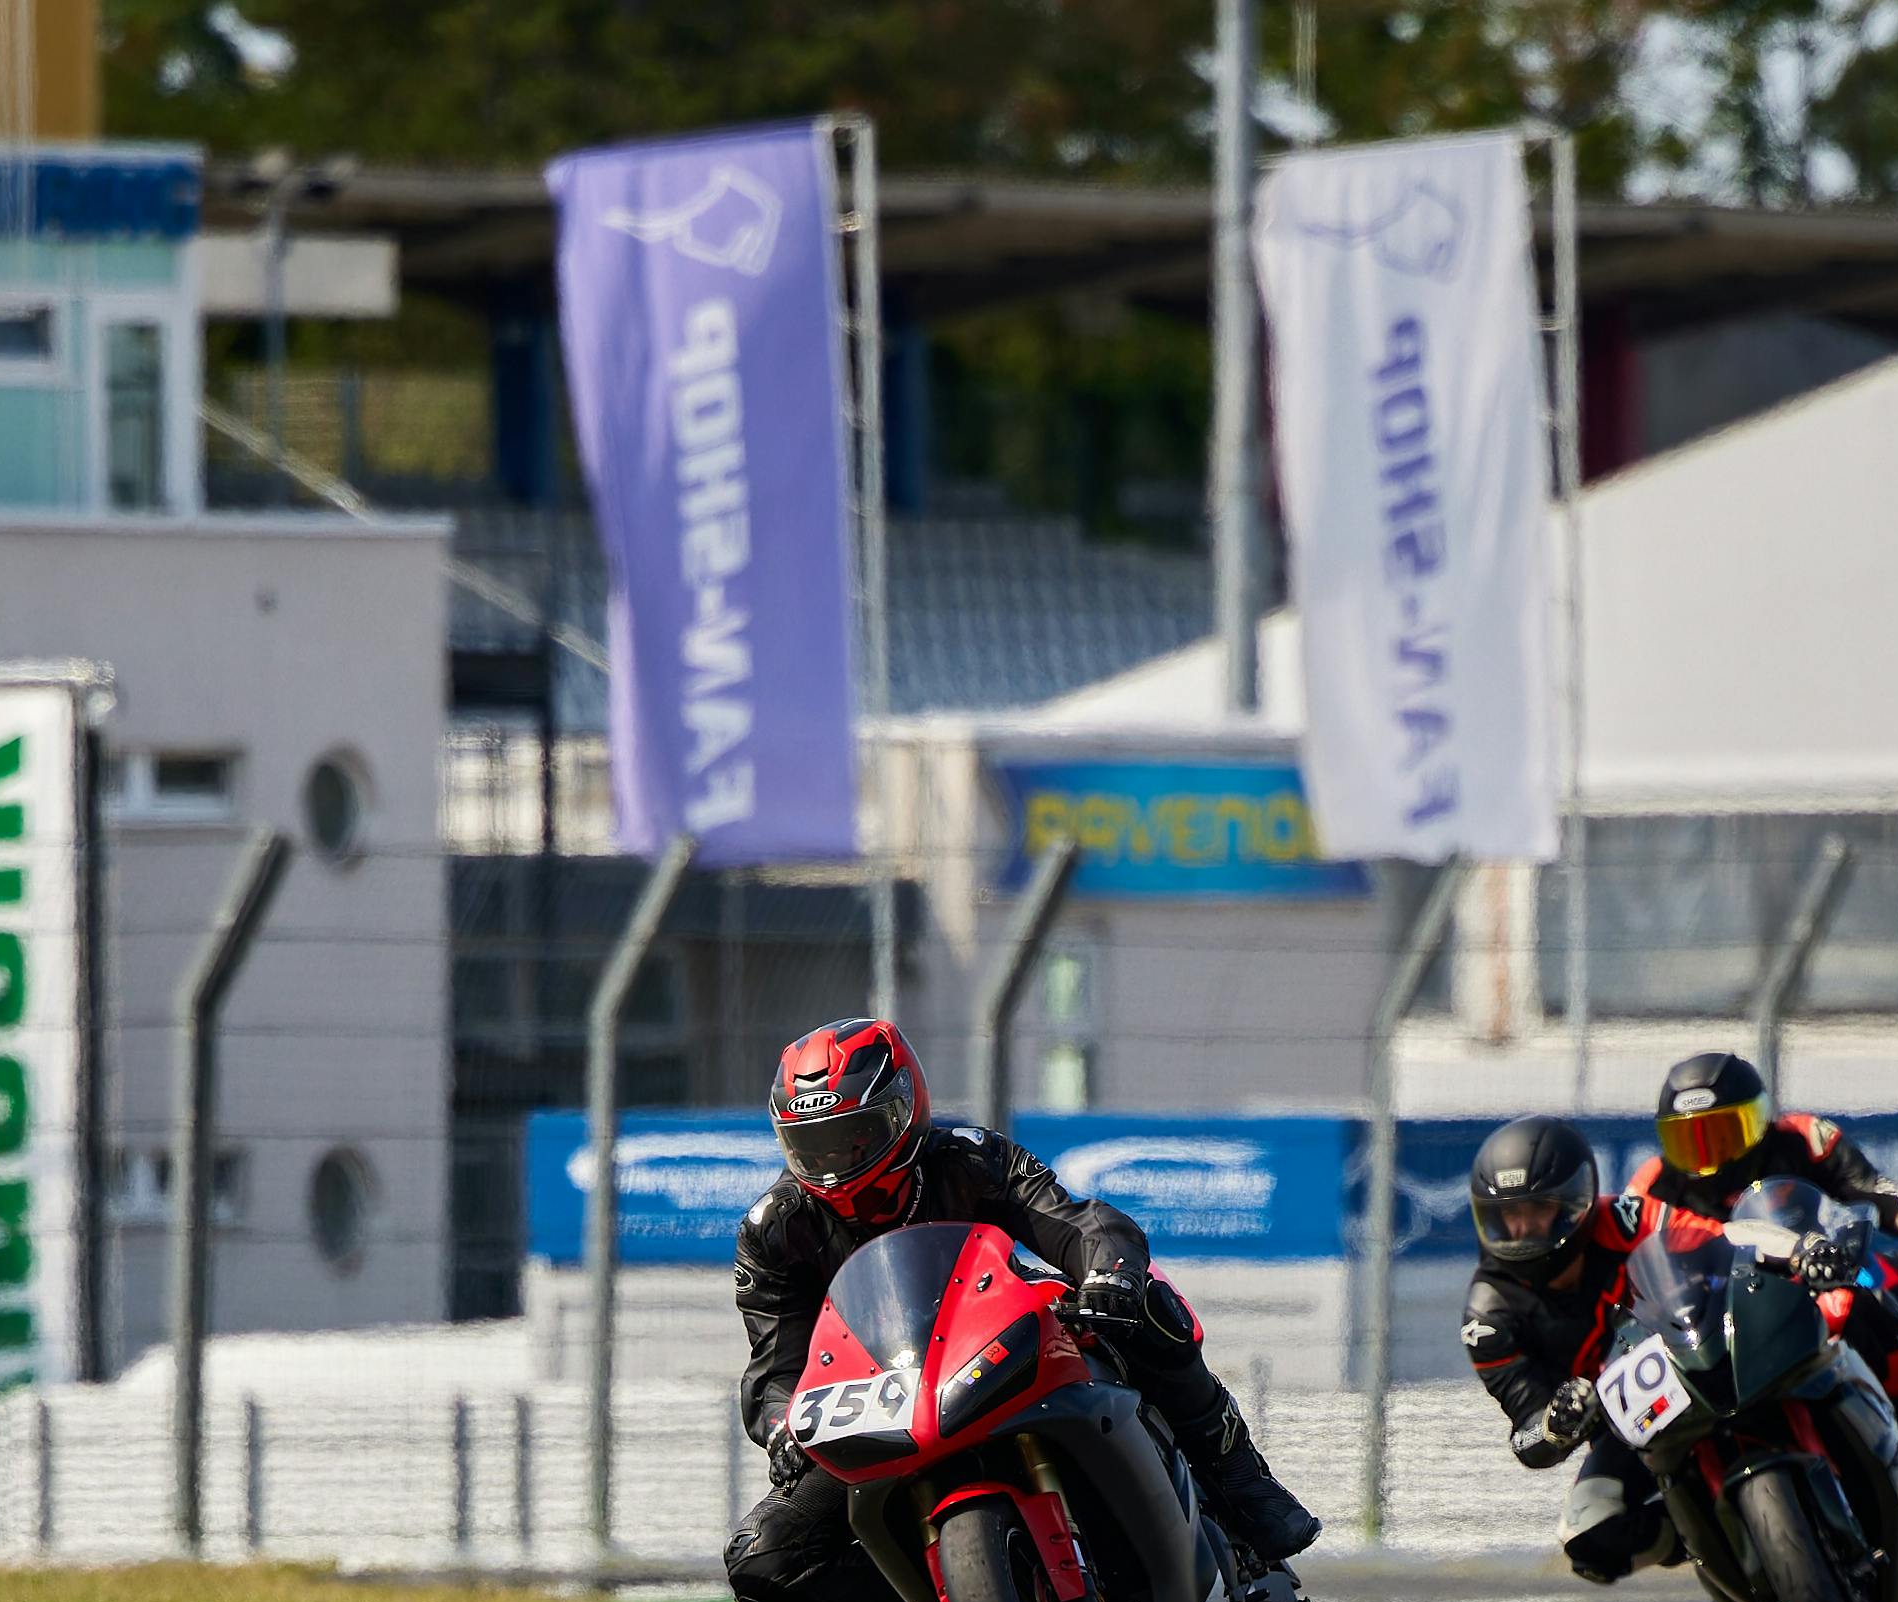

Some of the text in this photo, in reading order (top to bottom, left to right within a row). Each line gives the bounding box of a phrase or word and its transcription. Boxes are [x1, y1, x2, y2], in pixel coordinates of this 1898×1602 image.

[793, 1093, 834, 1112] HJC
[795, 1372, 913, 1443] 359
[1605, 1351, 1667, 1414] 70
